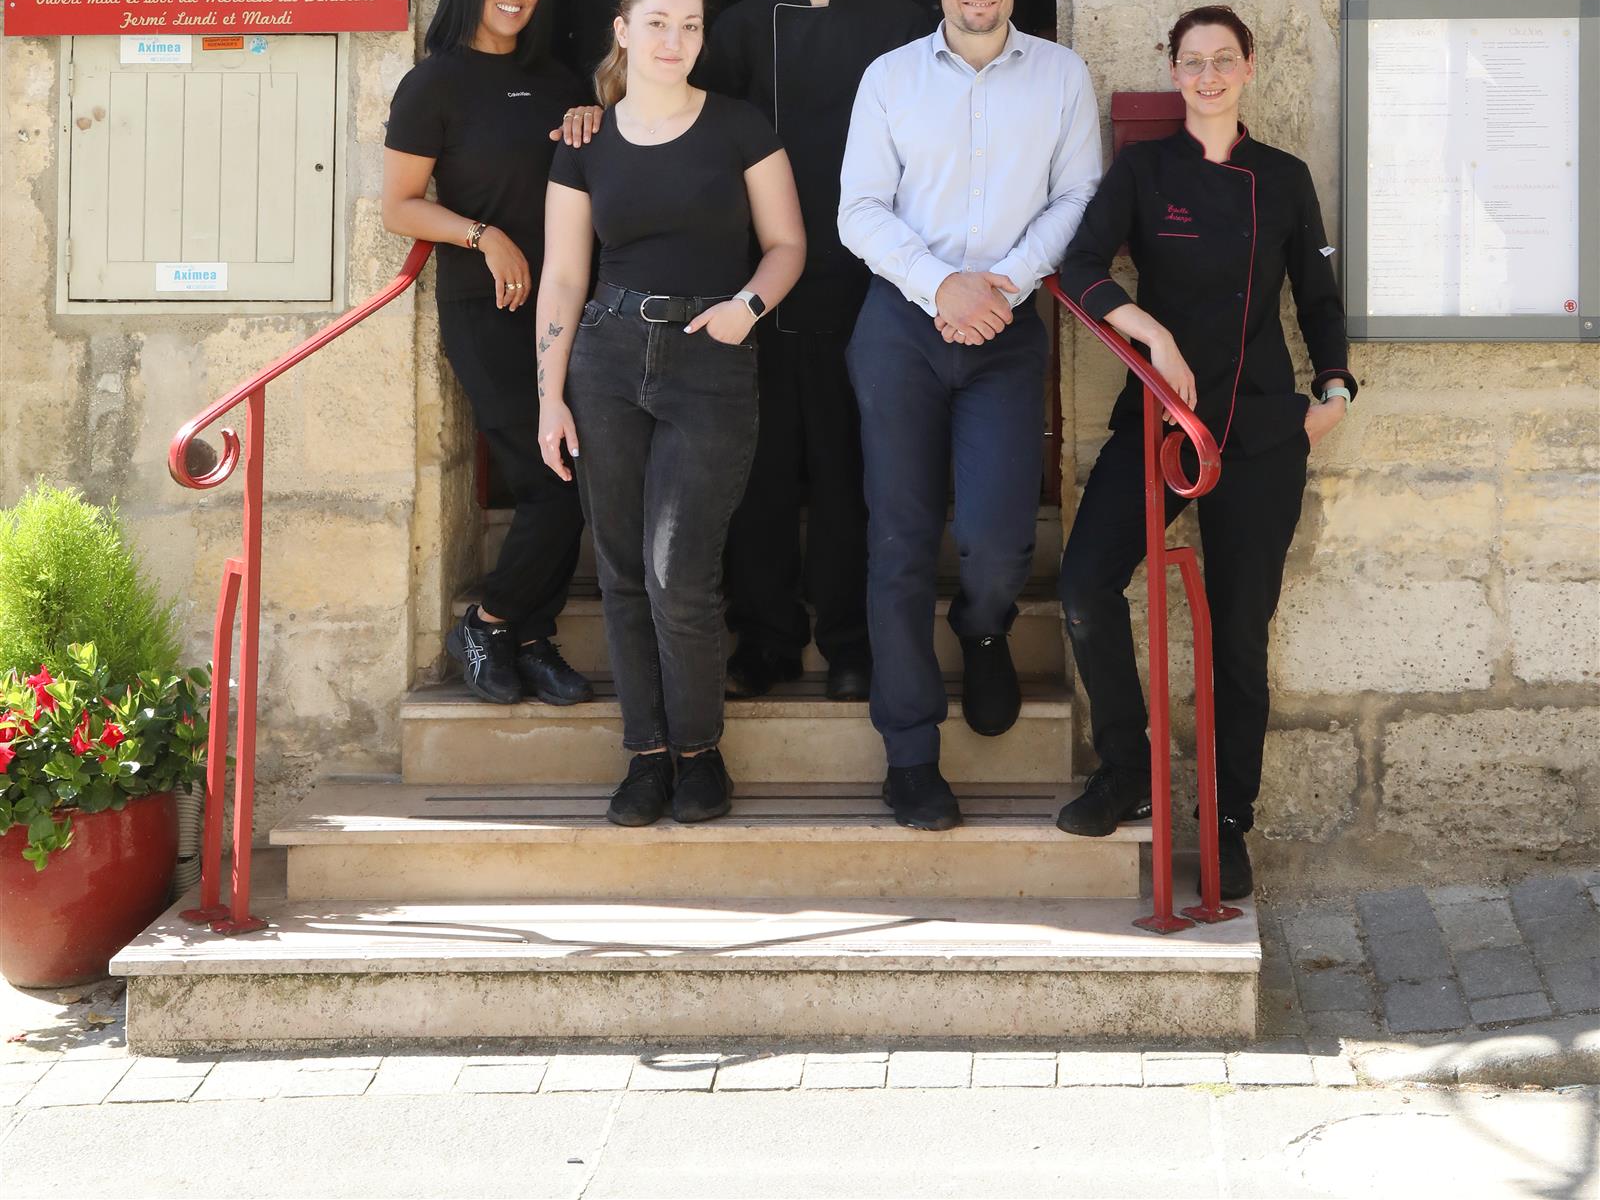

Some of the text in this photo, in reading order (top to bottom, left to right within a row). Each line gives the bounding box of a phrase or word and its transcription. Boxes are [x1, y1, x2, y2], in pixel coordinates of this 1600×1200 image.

[119, 10, 293, 29] Fermé Lundi et Mardi
